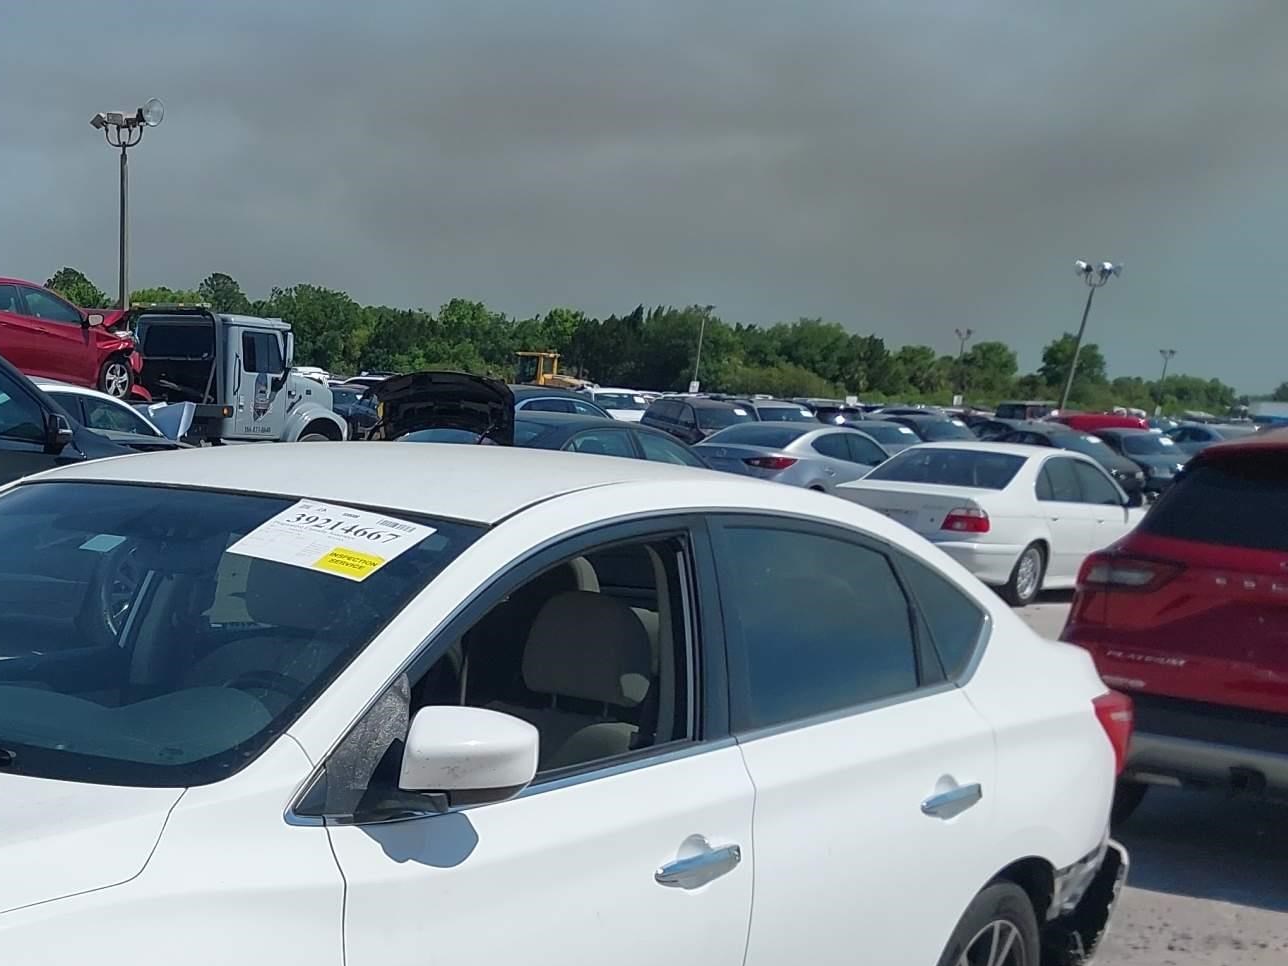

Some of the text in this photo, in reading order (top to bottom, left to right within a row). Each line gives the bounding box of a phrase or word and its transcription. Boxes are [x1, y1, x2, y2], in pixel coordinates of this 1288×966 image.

[286, 512, 402, 544] 39214667
[328, 558, 366, 570] SERVICE
[329, 552, 379, 568] INSPECTION
